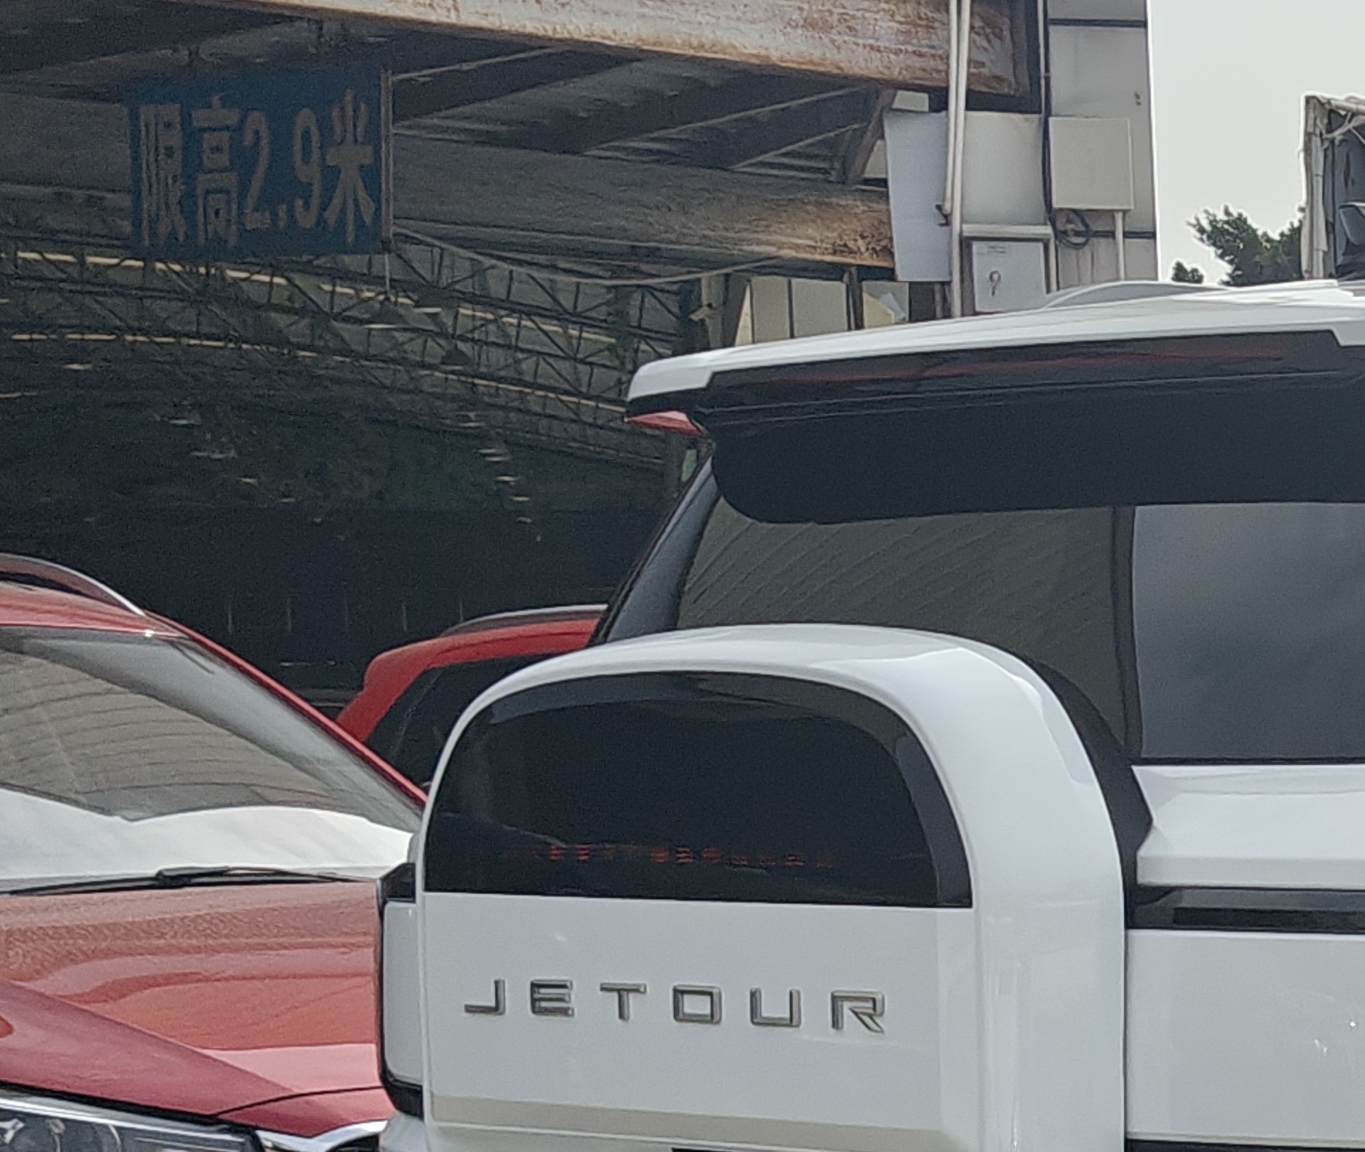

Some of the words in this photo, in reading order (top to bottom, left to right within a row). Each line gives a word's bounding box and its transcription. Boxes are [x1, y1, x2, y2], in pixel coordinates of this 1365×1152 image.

[139, 88, 376, 247] 限高2.9米
[463, 977, 886, 1034] JETOUR
